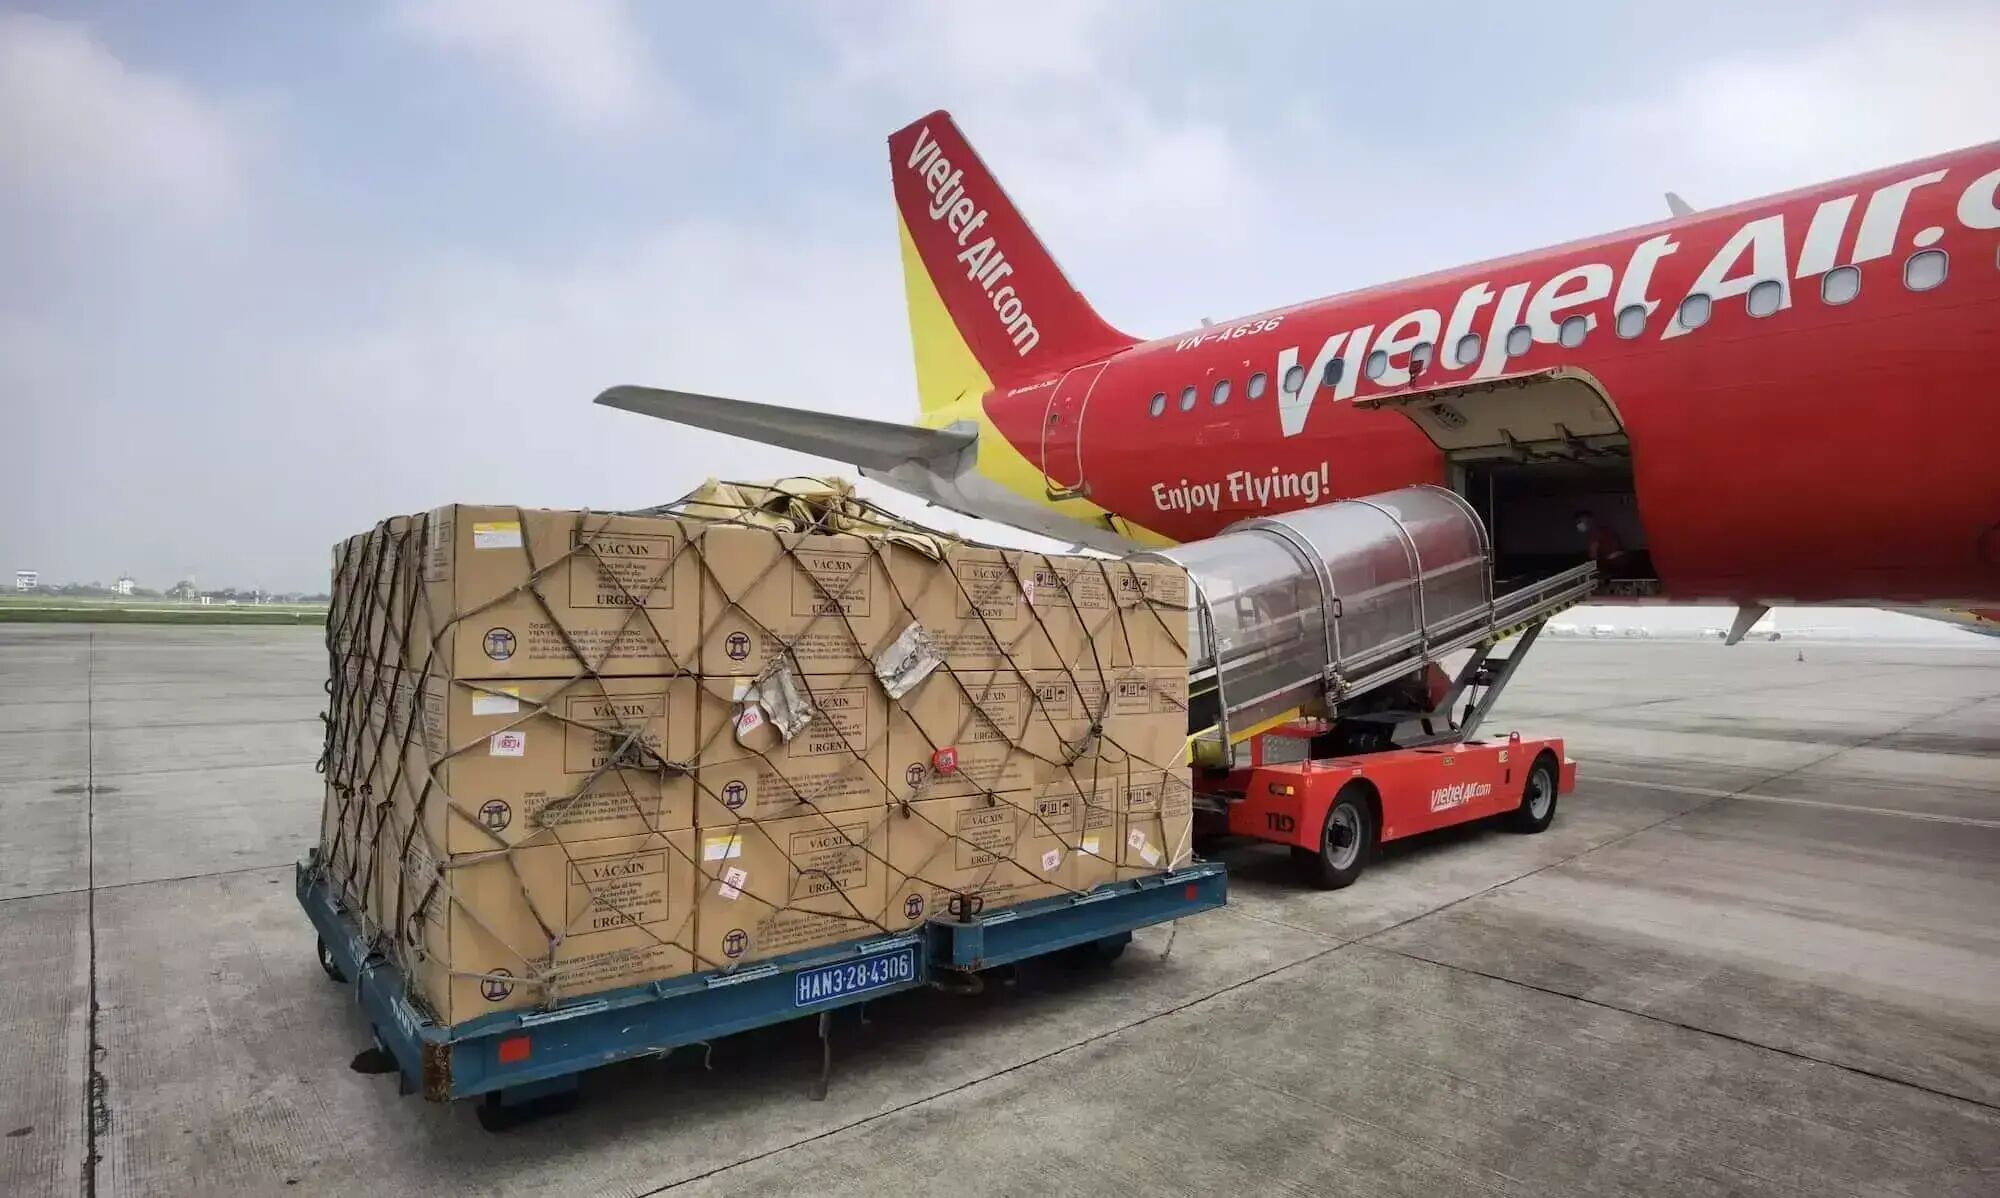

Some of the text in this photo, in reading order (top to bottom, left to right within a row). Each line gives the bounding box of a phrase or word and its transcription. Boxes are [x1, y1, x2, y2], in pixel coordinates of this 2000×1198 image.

[957, 236, 1041, 357] Air.com
[1176, 315, 1285, 352] VN-A636
[1151, 461, 1330, 514] Enjoy Flying!
[627, 544, 649, 555] XIN
[622, 704, 645, 716] XIN
[809, 742, 848, 753] URGENT
[621, 863, 645, 876] XIN
[593, 911, 645, 930] URGENT
